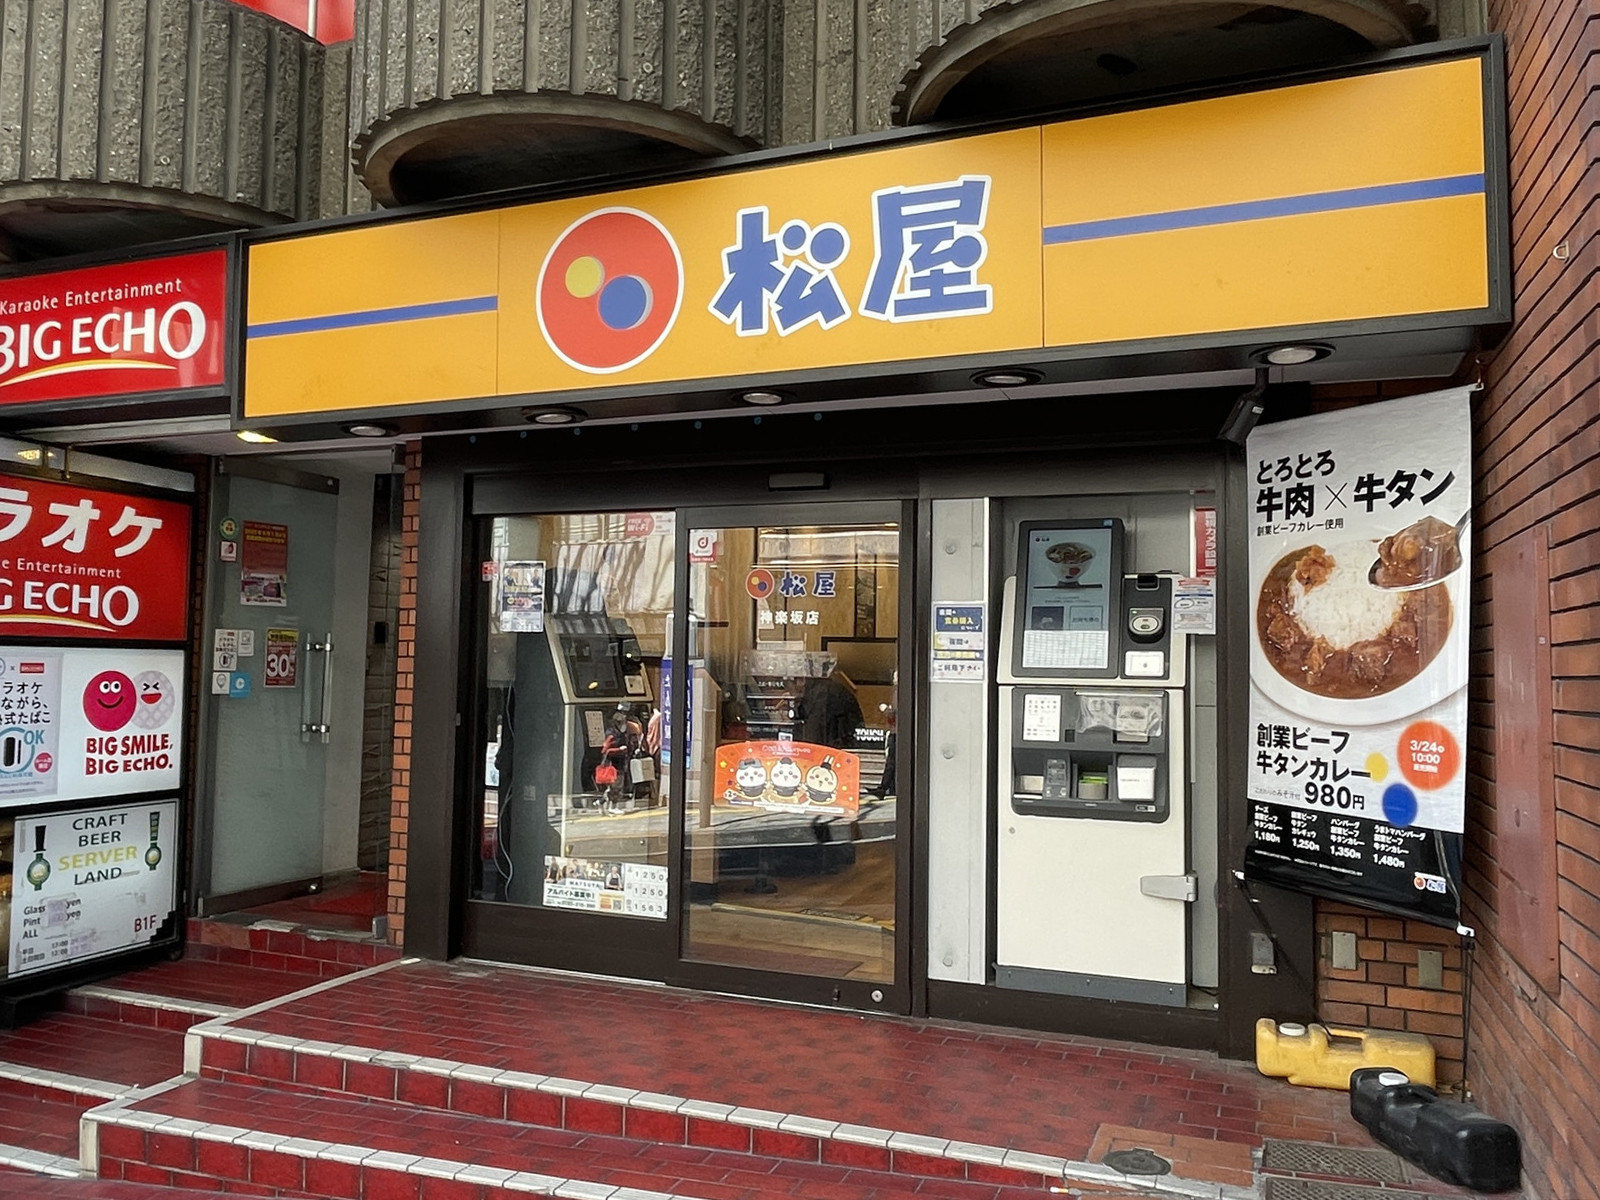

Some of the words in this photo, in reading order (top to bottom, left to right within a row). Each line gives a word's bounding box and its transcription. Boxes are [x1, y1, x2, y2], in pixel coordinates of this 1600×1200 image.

[708, 174, 993, 336] 松屋
[0, 294, 58, 316] Karaoke
[65, 278, 183, 308] Entertainment
[71, 300, 207, 360] ECHO
[1256, 449, 1336, 484] とろとろ
[1257, 517, 1344, 537] 創業ビーフカレー使用
[17, 558, 122, 579] Entertainment
[778, 570, 836, 598] 松屋
[23, 580, 140, 627] ECHO
[759, 610, 820, 626] 神楽坂店
[24, 729, 45, 746] OK
[86, 736, 118, 756] BIG
[1257, 722, 1350, 755] 創業ビーフ
[85, 757, 119, 776] BIG
[122, 753, 173, 772] ECHO.
[1257, 750, 1371, 783] 牛タンカレー
[1411, 752, 1441, 764] 10:00
[1304, 781, 1365, 811] 980円
[72, 813, 128, 830] CRAFT
[78, 831, 121, 847] BEER
[58, 846, 138, 872] SERVER
[74, 867, 122, 886] LAND
[23, 905, 46, 916] Glass
[23, 917, 41, 927] Pint
[134, 915, 157, 932] B1F
[22, 928, 39, 940] ALL
